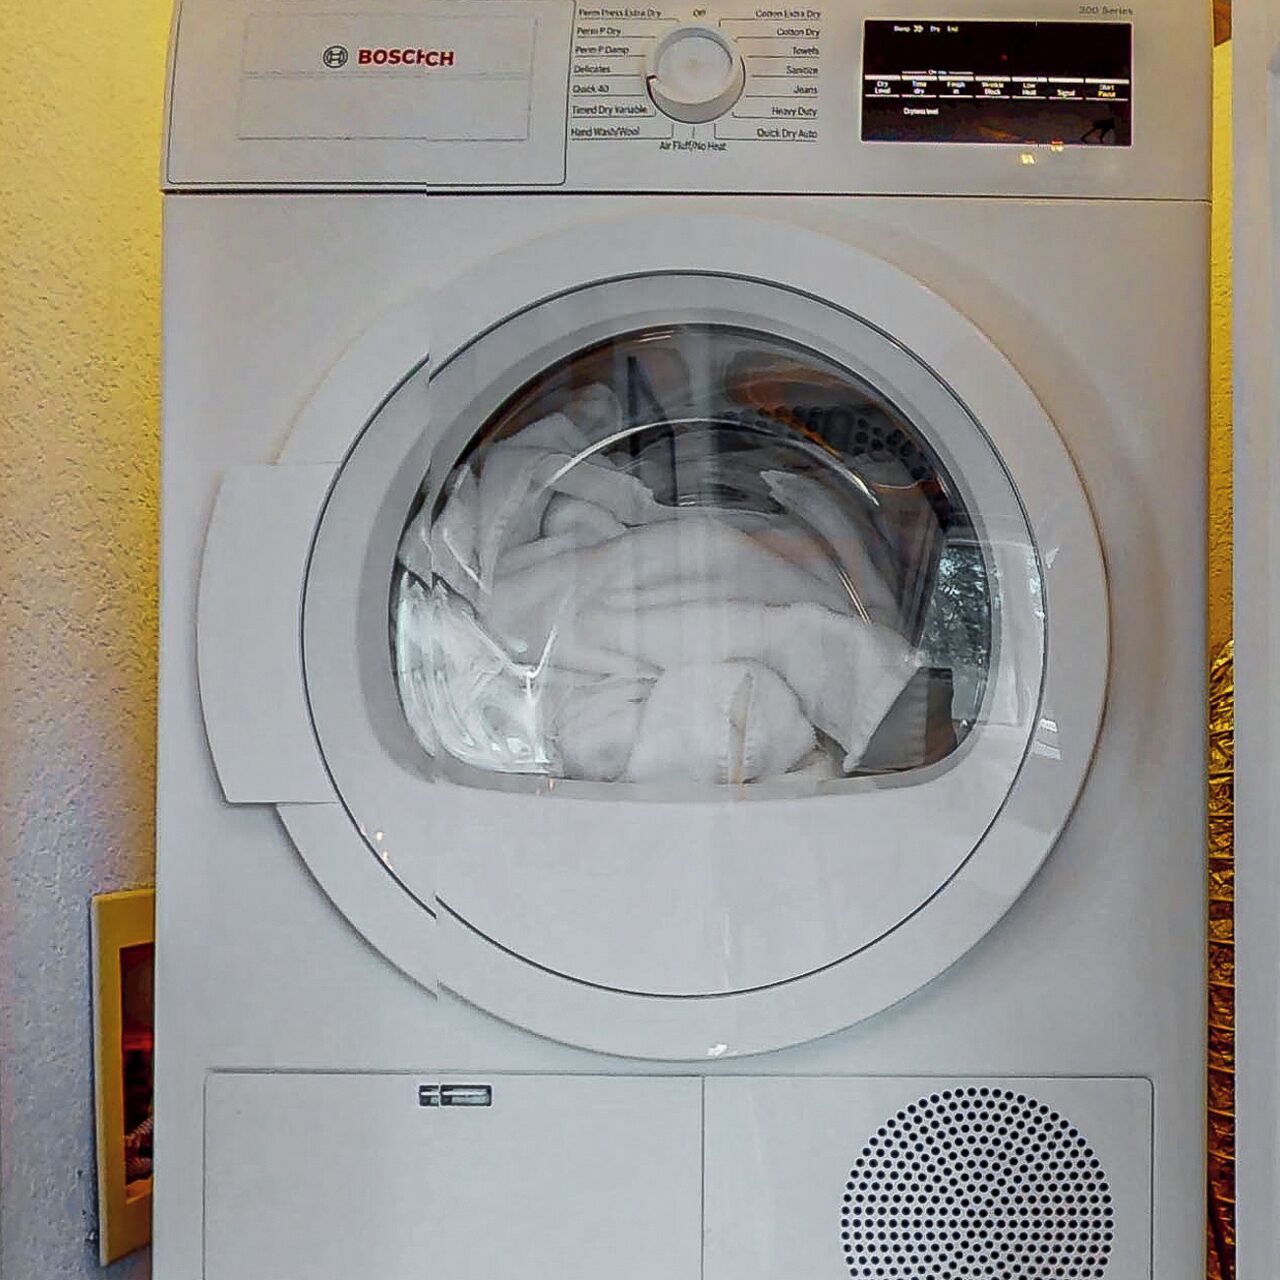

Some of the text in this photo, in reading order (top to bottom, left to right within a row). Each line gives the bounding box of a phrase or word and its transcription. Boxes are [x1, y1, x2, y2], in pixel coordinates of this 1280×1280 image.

[647, 9, 662, 18] Dry
[807, 10, 821, 19] Dry
[577, 27, 621, 37] Perm P Dry
[805, 28, 820, 37] Dry
[599, 45, 605, 53] P
[605, 46, 630, 55] Damp
[574, 65, 611, 73] Delicates
[572, 85, 597, 93] Quick
[793, 84, 818, 94] Jeans
[572, 105, 649, 116] Timed Dry Variable
[772, 107, 818, 117] Heavy Duty
[571, 127, 593, 137] Hand
[756, 128, 818, 139] Quick Dry Auto
[659, 141, 671, 150] Air
